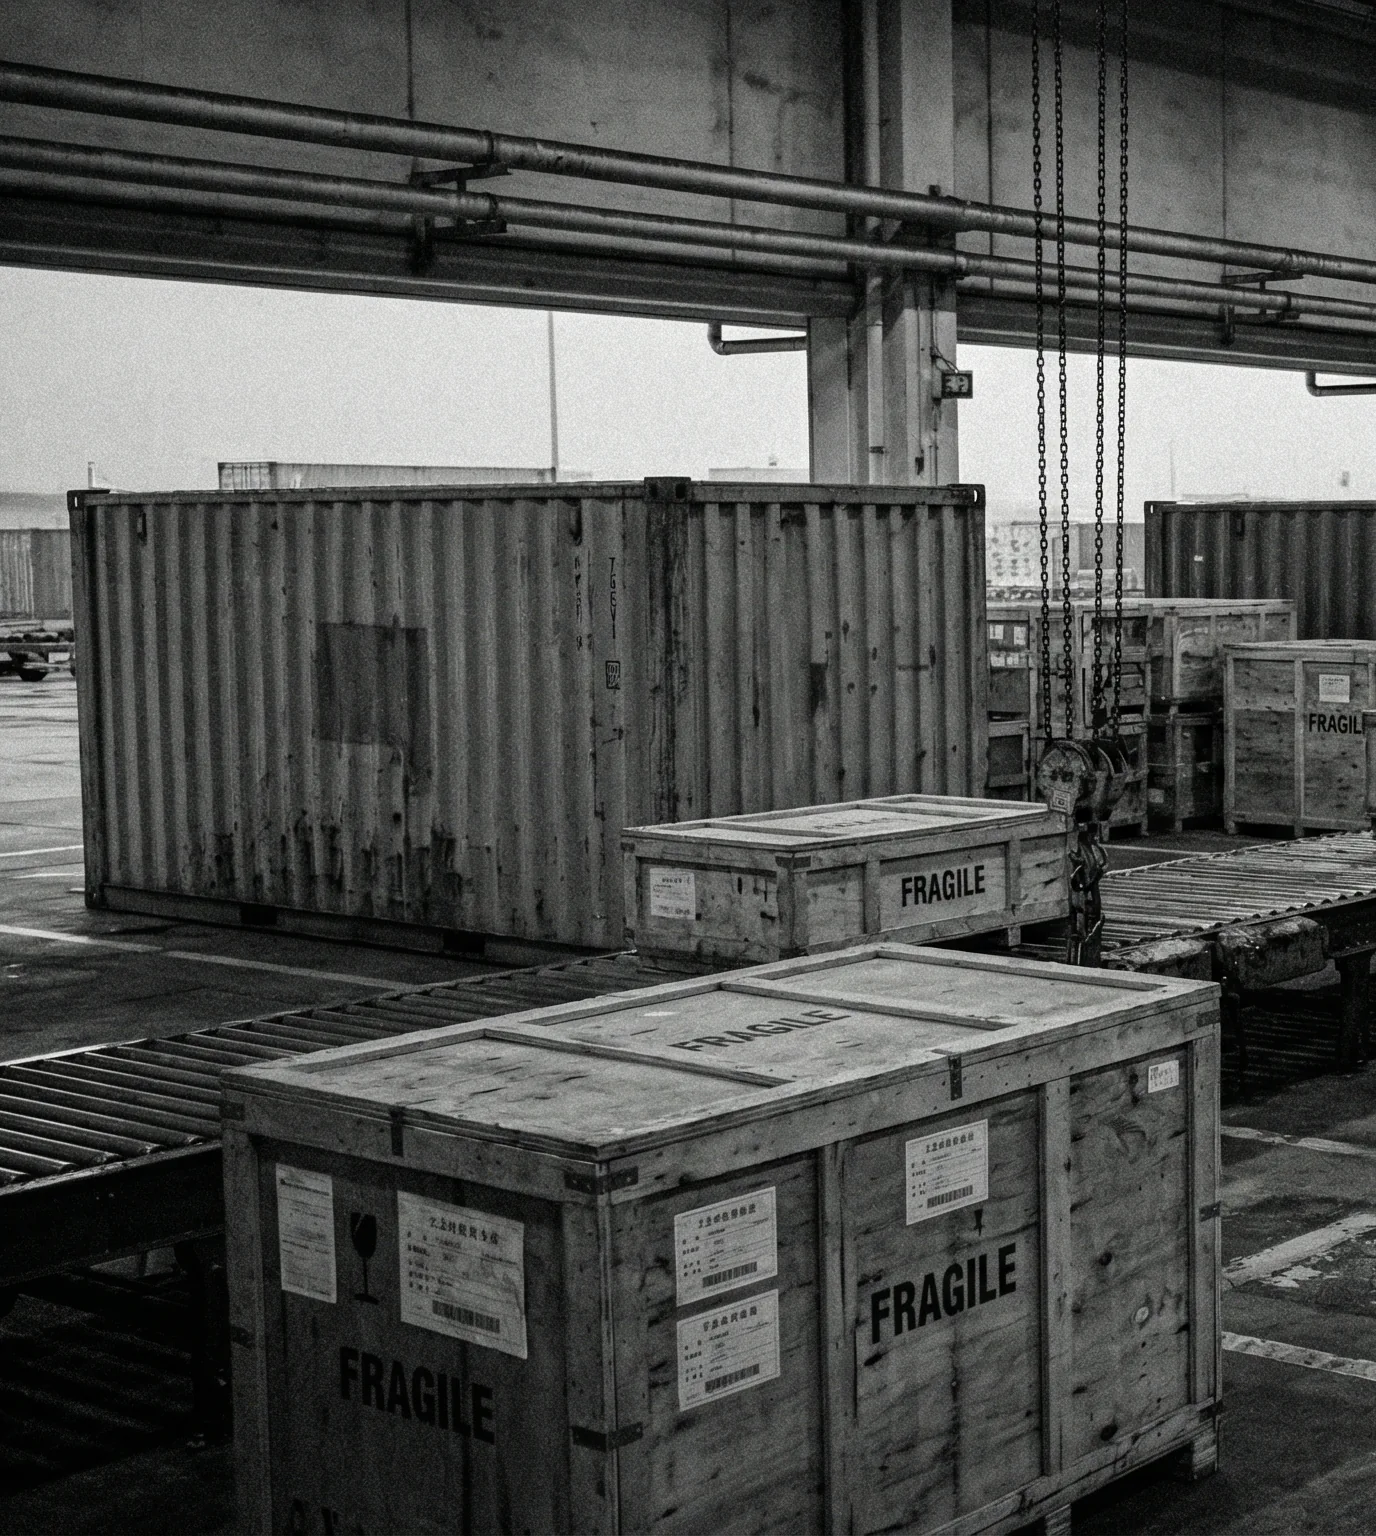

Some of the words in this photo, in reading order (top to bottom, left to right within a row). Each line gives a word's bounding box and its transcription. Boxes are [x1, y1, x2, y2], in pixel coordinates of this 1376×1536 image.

[902, 865, 985, 907] FRAGILE
[667, 1010, 852, 1052] FRAGILE
[870, 1243, 1016, 1345] FRAGILE
[340, 1346, 495, 1445] FRAGILE
